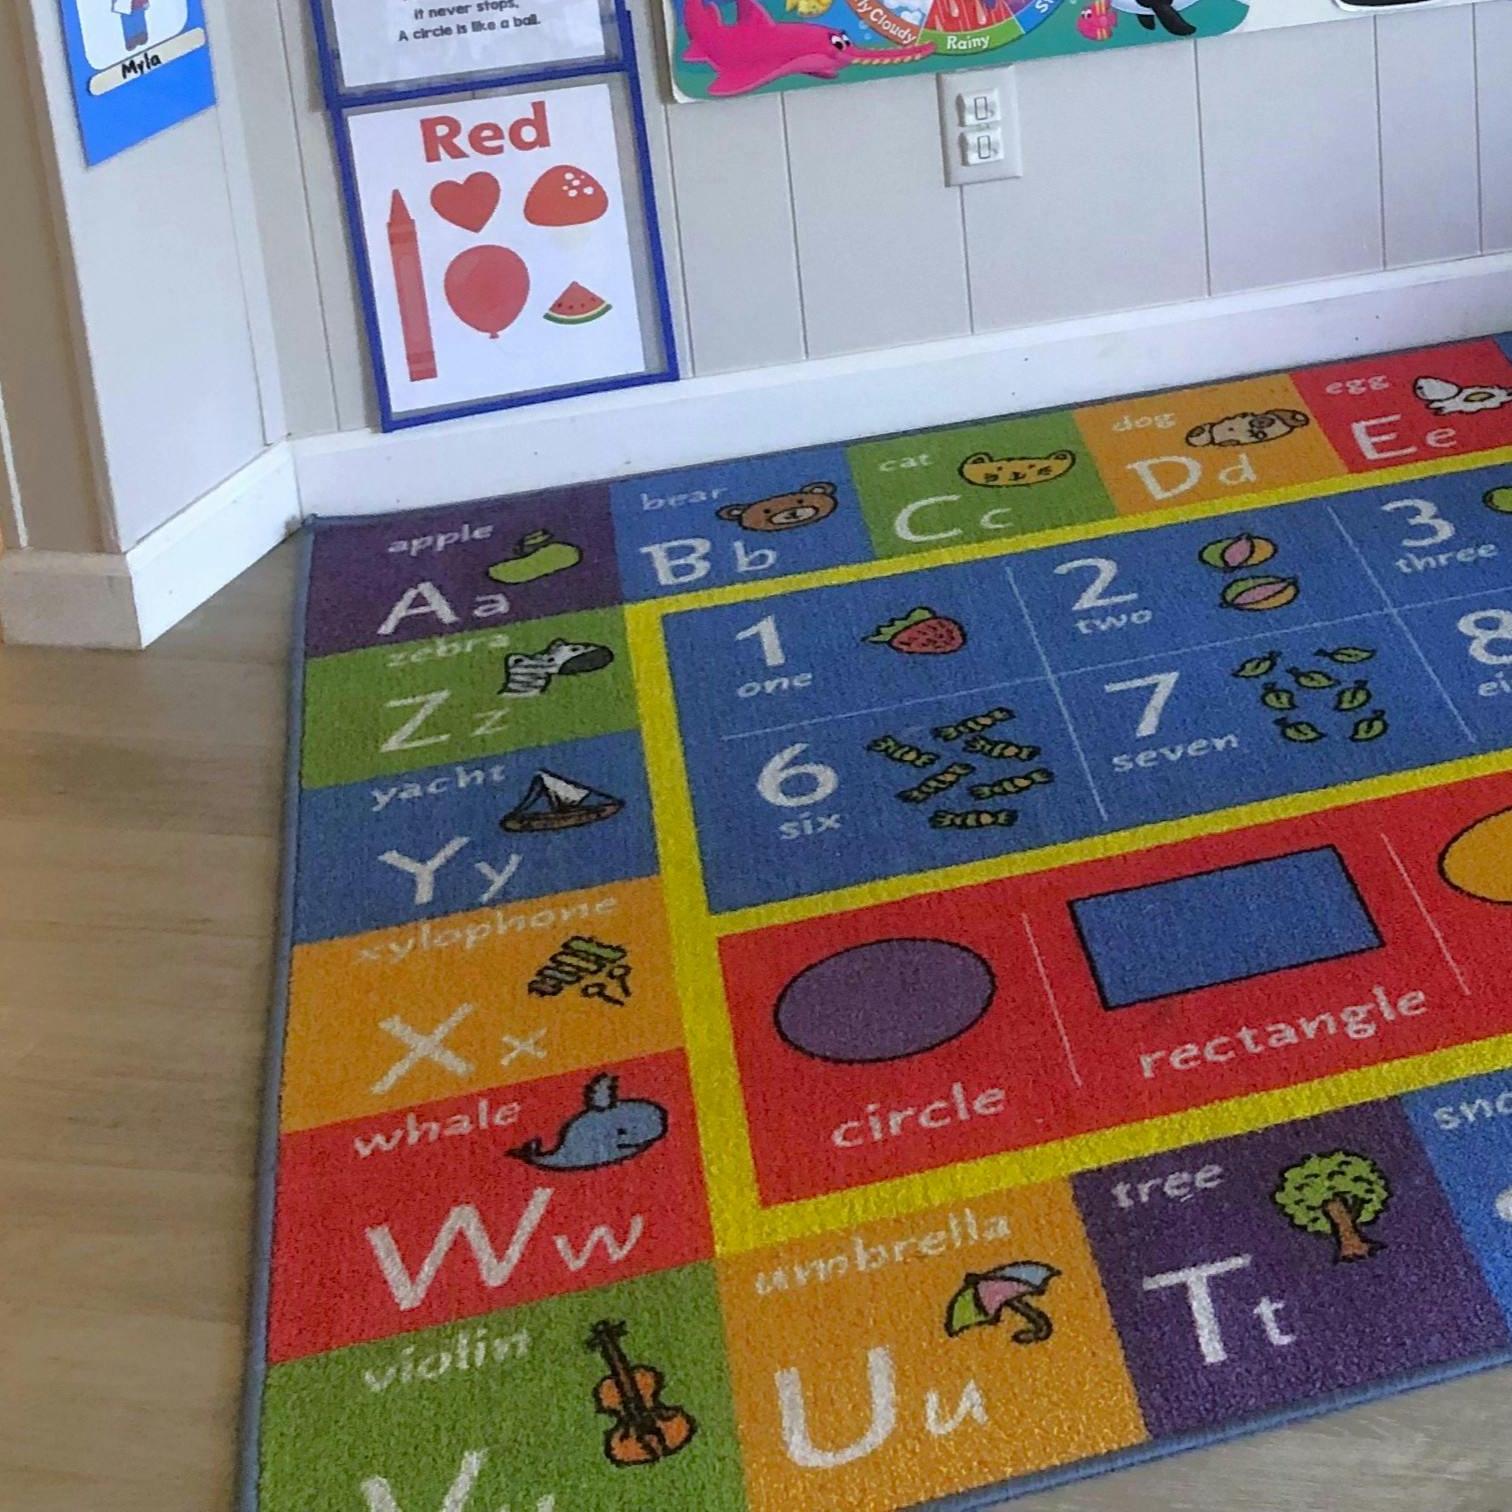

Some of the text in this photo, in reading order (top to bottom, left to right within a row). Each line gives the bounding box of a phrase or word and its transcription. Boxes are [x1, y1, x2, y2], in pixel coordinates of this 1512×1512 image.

[870, 8, 917, 46] Cloudy
[946, 36, 989, 50] Rainy
[122, 52, 161, 79] Myla
[420, 101, 551, 162] Red
[1325, 372, 1390, 397] egg
[1111, 412, 1176, 434] dog
[878, 452, 933, 474] cat
[639, 488, 726, 512] bear
[1381, 498, 1456, 548] 3
[387, 524, 495, 558] apple
[1395, 540, 1497, 574] three
[377, 580, 457, 635] A
[1053, 557, 1138, 612] 2
[736, 614, 787, 669] 1
[1075, 607, 1153, 635] two
[386, 633, 512, 668] zebra
[736, 670, 814, 698] one
[1104, 670, 1181, 738] 7
[378, 689, 450, 754] Z
[755, 741, 840, 808] 6
[1110, 731, 1240, 773] seven
[370, 762, 508, 811] yacht
[777, 811, 841, 840] six
[352, 894, 619, 965] xylophone
[370, 1003, 475, 1096] X
[1138, 986, 1429, 1080] rectangle
[352, 1097, 523, 1160] whale
[832, 1082, 1006, 1150] circle
[1109, 1160, 1225, 1212] tree
[755, 1207, 1011, 1296] umbrella
[362, 1327, 531, 1393] violin
